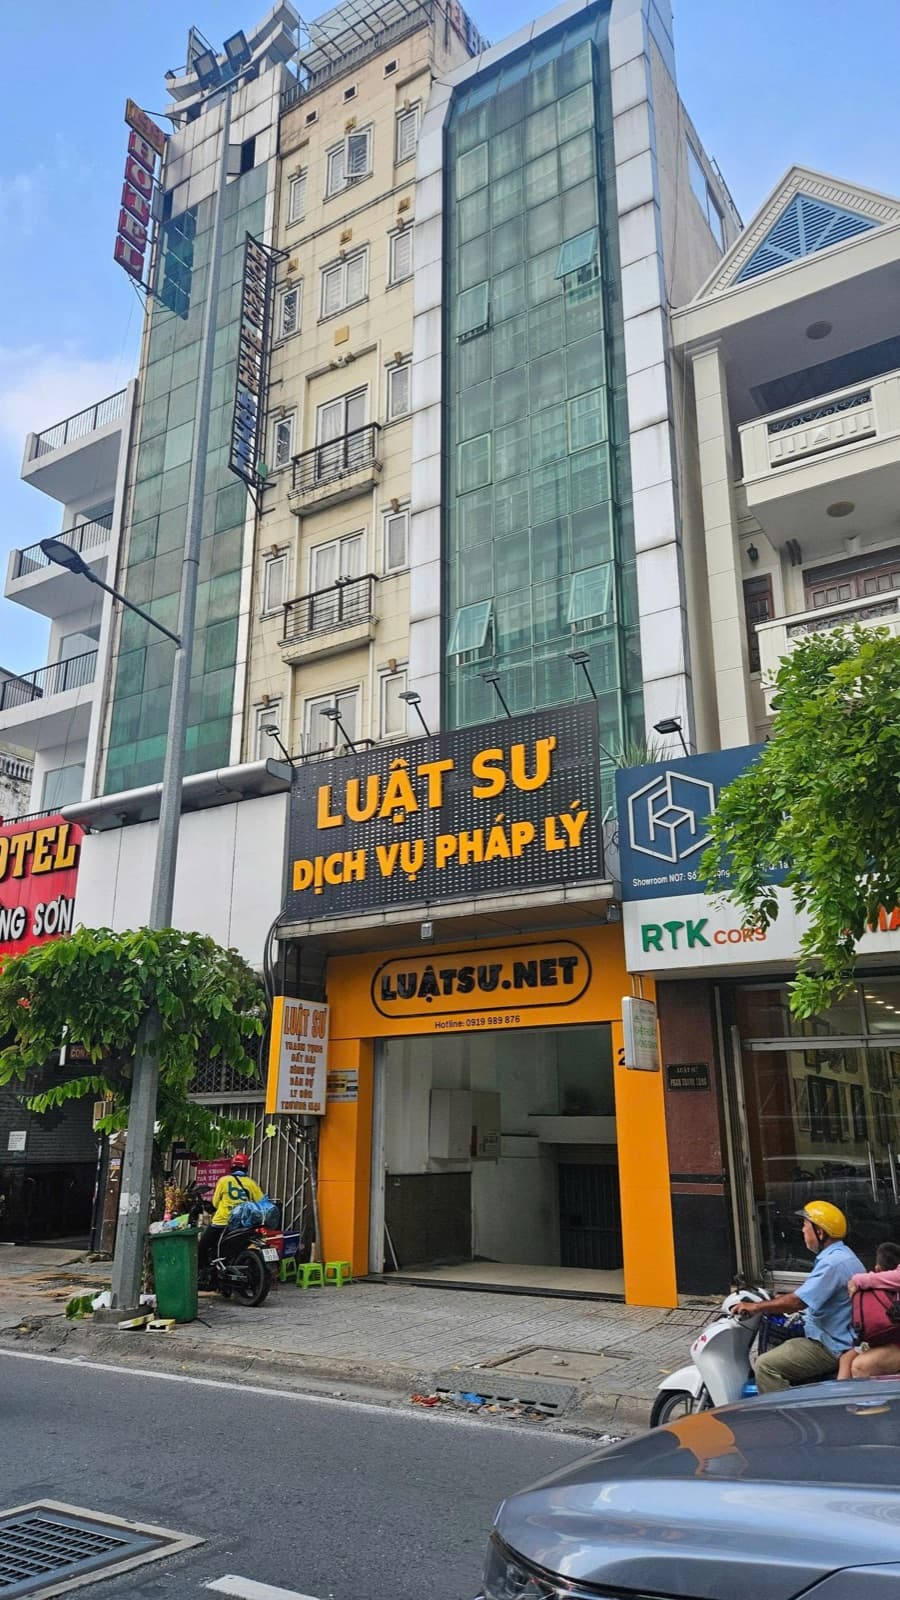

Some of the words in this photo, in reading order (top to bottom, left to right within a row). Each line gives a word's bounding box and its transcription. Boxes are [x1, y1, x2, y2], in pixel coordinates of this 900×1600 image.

[119, 131, 154, 271] HOTEL
[316, 758, 455, 830] LUẬT
[471, 735, 557, 800] SƯ
[292, 849, 366, 895] DỊCH
[376, 839, 424, 881] VỤ
[435, 814, 535, 869] PHÁP
[544, 799, 590, 851] LÝ
[632, 877, 668, 887] Showroom
[687, 870, 697, 880] Số
[32, 895, 72, 936] SƠN
[641, 918, 712, 952] RTK
[714, 927, 766, 944] CORS
[381, 956, 579, 1003] LUẬTSƯ.NET
[284, 1003, 310, 1041] LUẬT
[311, 1008, 327, 1039] SƯ
[434, 1019, 464, 1029] Hotline:
[466, 1017, 485, 1027] 0919
[487, 1016, 503, 1025] 989
[504, 1015, 521, 1024] 876
[285, 1041, 305, 1051] TRANH
[307, 1043, 323, 1053] TỤNG
